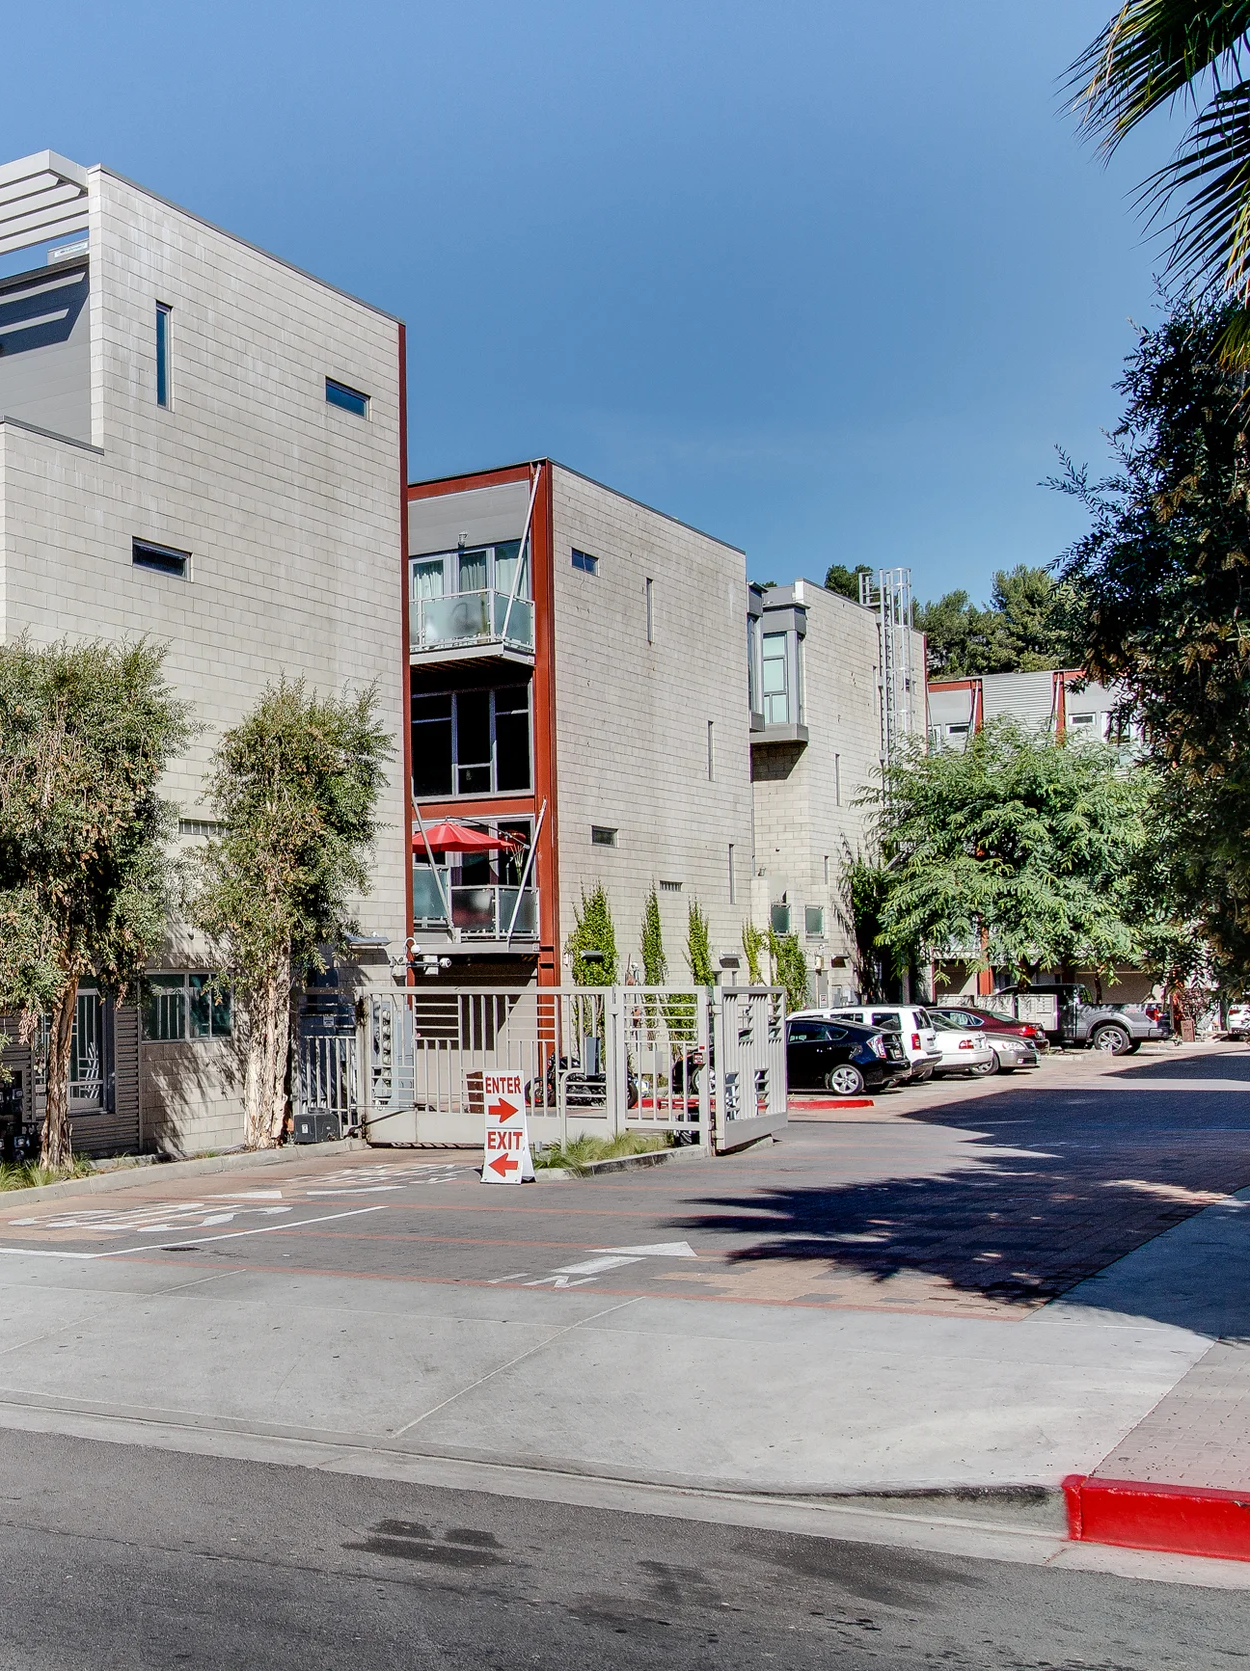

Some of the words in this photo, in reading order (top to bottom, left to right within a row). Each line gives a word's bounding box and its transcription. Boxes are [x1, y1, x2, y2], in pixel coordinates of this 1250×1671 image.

[485, 1075, 522, 1094] ENTER
[487, 1131, 523, 1150] EXIT
[487, 1272, 600, 1288] IN
